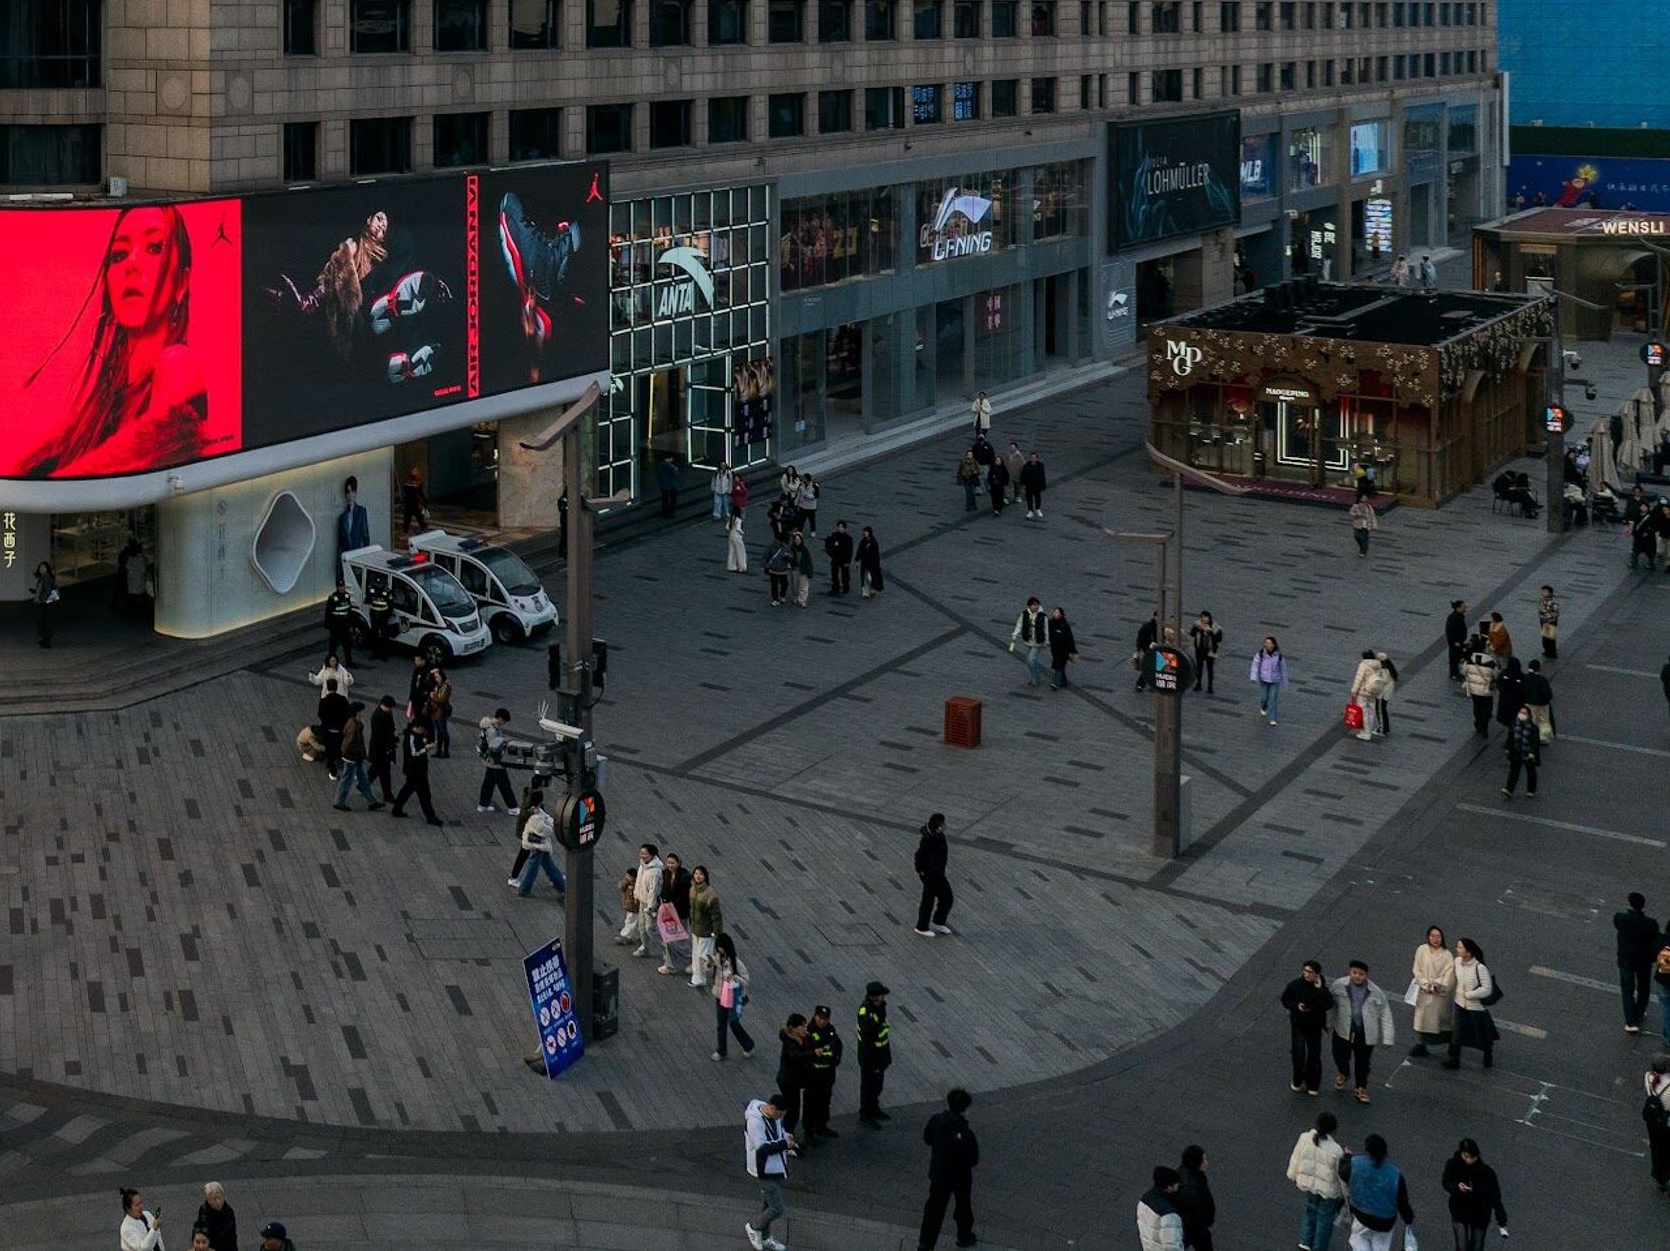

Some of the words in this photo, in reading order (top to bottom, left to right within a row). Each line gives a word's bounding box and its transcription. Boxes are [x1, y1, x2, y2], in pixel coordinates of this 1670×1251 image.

[1602, 221, 1664, 234] WENSLI
[467, 212, 478, 330] JORDAN
[657, 282, 693, 317] ANTA
[467, 345, 478, 393] AIR
[3, 512, 17, 569] 花西子
